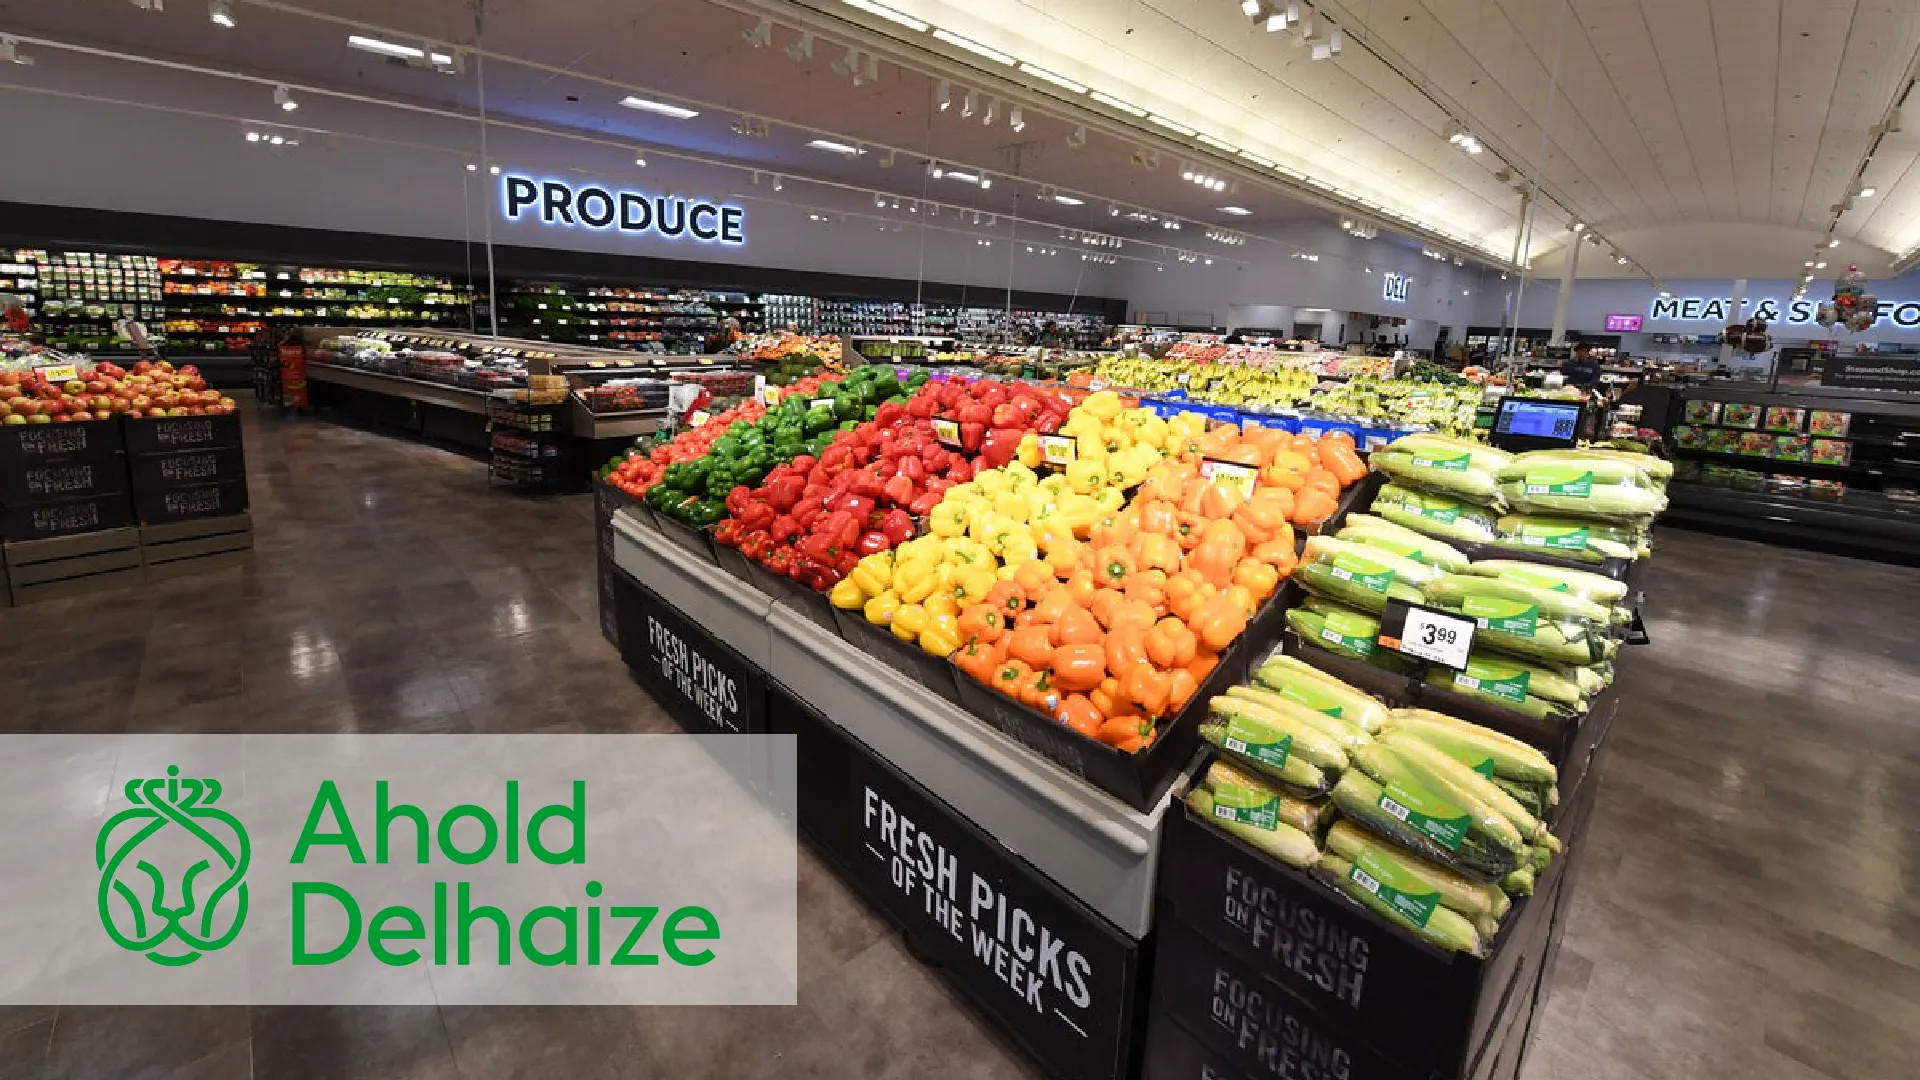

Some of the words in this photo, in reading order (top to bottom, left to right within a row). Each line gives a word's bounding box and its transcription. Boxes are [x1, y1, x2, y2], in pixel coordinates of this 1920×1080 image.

[506, 176, 743, 243] PRODUCE
[1754, 300, 1779, 322] &
[1788, 300, 1920, 326] SFO
[648, 615, 689, 674] FRESH
[692, 650, 739, 714] PICKS
[662, 657, 673, 681] OF
[675, 668, 693, 701] THE
[694, 684, 723, 727] WEEK
[864, 785, 958, 902] FRESH
[970, 871, 1092, 1009] PICKS
[892, 855, 916, 896] OF
[922, 881, 964, 943] THE
[971, 921, 1044, 1014] WEEK
[1226, 866, 1369, 973] FOCUSING
[1225, 896, 1249, 925] ON
[1252, 913, 1363, 1010] FRESH
[1213, 996, 1236, 1027] ON
[1213, 968, 1350, 1080] FOCUSING
